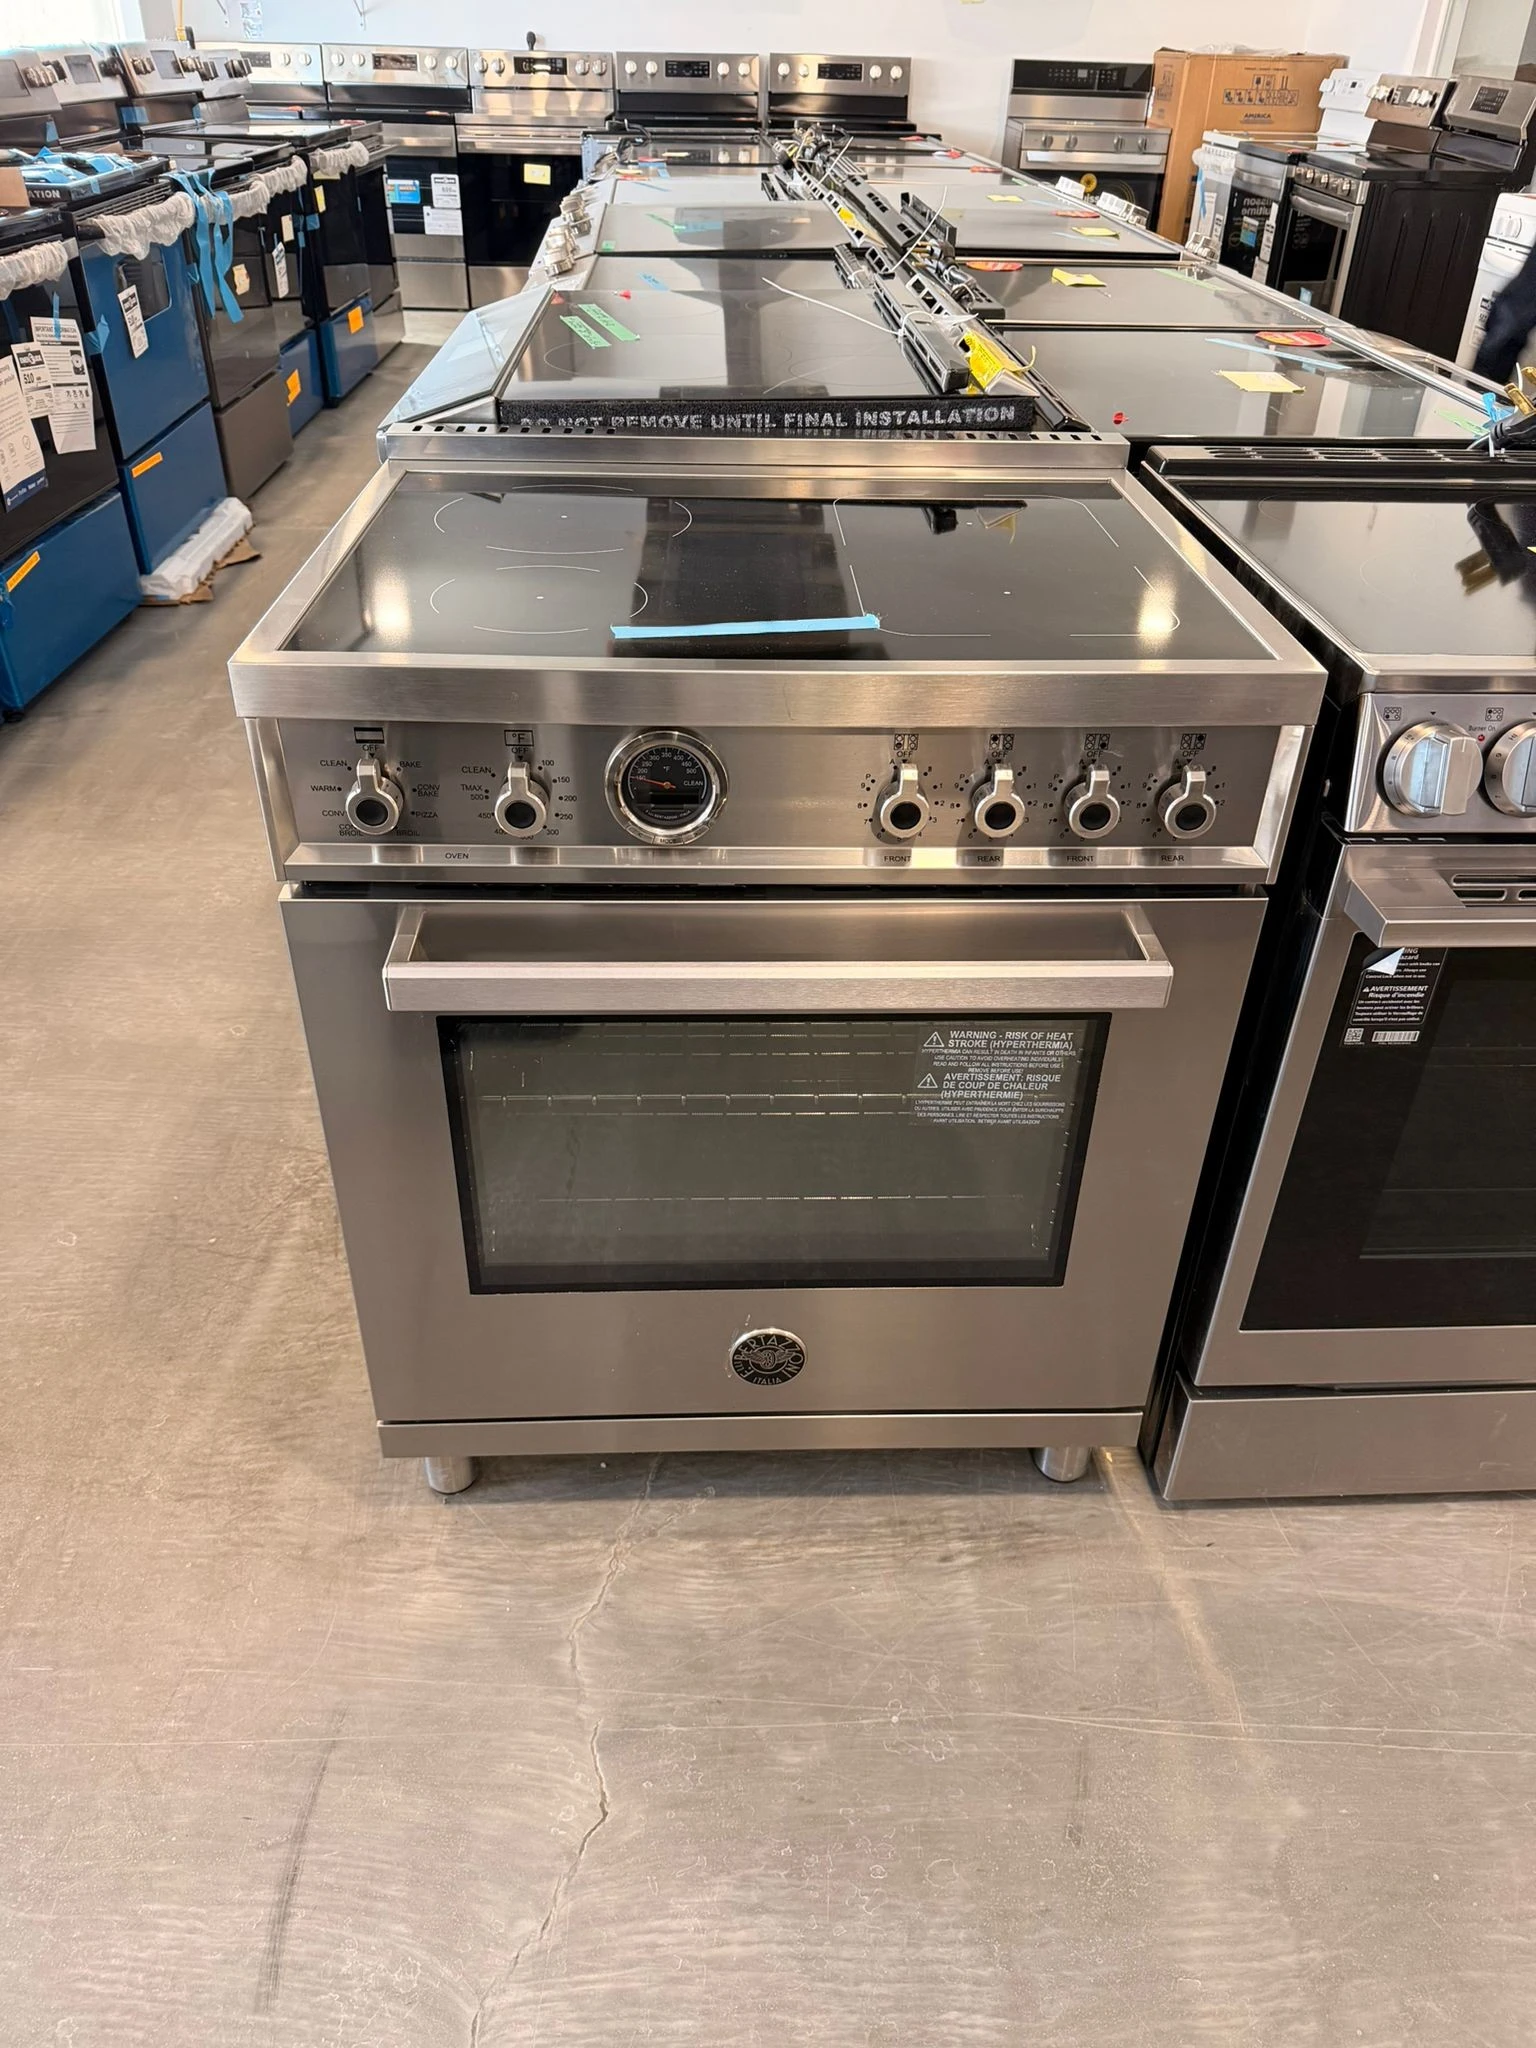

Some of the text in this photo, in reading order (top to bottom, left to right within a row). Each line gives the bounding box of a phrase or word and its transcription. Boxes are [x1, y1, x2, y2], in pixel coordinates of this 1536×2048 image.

[611, 414, 702, 429] REMOVE
[710, 413, 777, 429] UNTIL
[784, 412, 848, 428] FINAL
[855, 406, 1015, 426] INSTALLATION
[362, 744, 379, 752] OFF
[320, 759, 347, 767] CLEAN
[461, 766, 492, 774] CLEAN
[415, 811, 438, 819] PIZZA
[478, 812, 492, 820] 450
[950, 1030, 997, 1039] WARNING
[1005, 1031, 1029, 1040] RISK
[1030, 1031, 1045, 1040] OF
[1046, 1032, 1074, 1040] HEAT
[948, 1039, 1073, 1051] STROKE (HYPERTHERMIA)
[943, 1073, 1062, 1082] AVERTISSEMENT: RISQUE
[942, 1081, 1048, 1090] DE COUP DE CHALEUR
[941, 1090, 1024, 1101] (HYPERTHERMIE)
[753, 1377, 782, 1385] ITALIA
